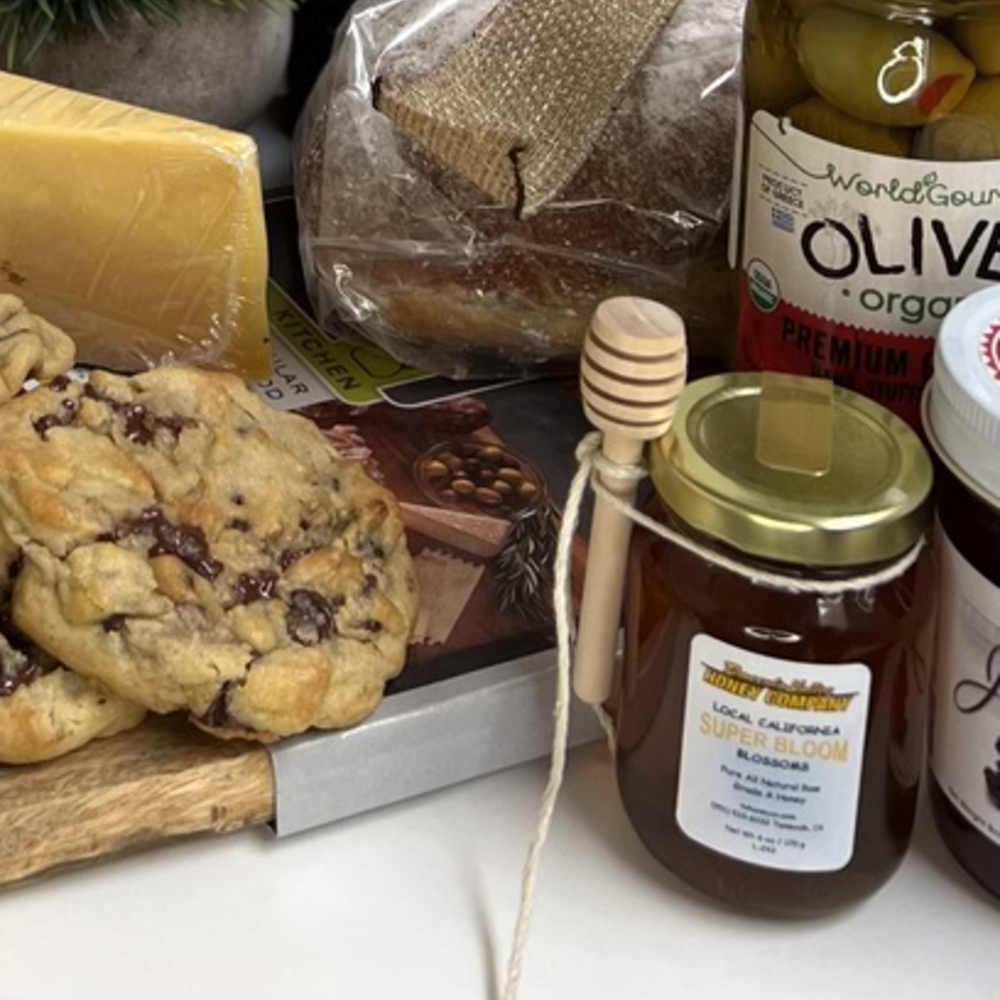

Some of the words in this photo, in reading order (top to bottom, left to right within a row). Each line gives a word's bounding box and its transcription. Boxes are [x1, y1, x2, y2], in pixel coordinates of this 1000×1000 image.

[859, 288, 963, 324] orga
[276, 309, 362, 392] KITCHEN
[781, 315, 910, 377] PREMIUM
[699, 712, 768, 747] SUPER
[774, 736, 849, 764] BLOOM
[712, 701, 752, 724] LOCAL
[758, 717, 840, 736] CALIFORNIA
[736, 747, 810, 771] BLOSSOMS
